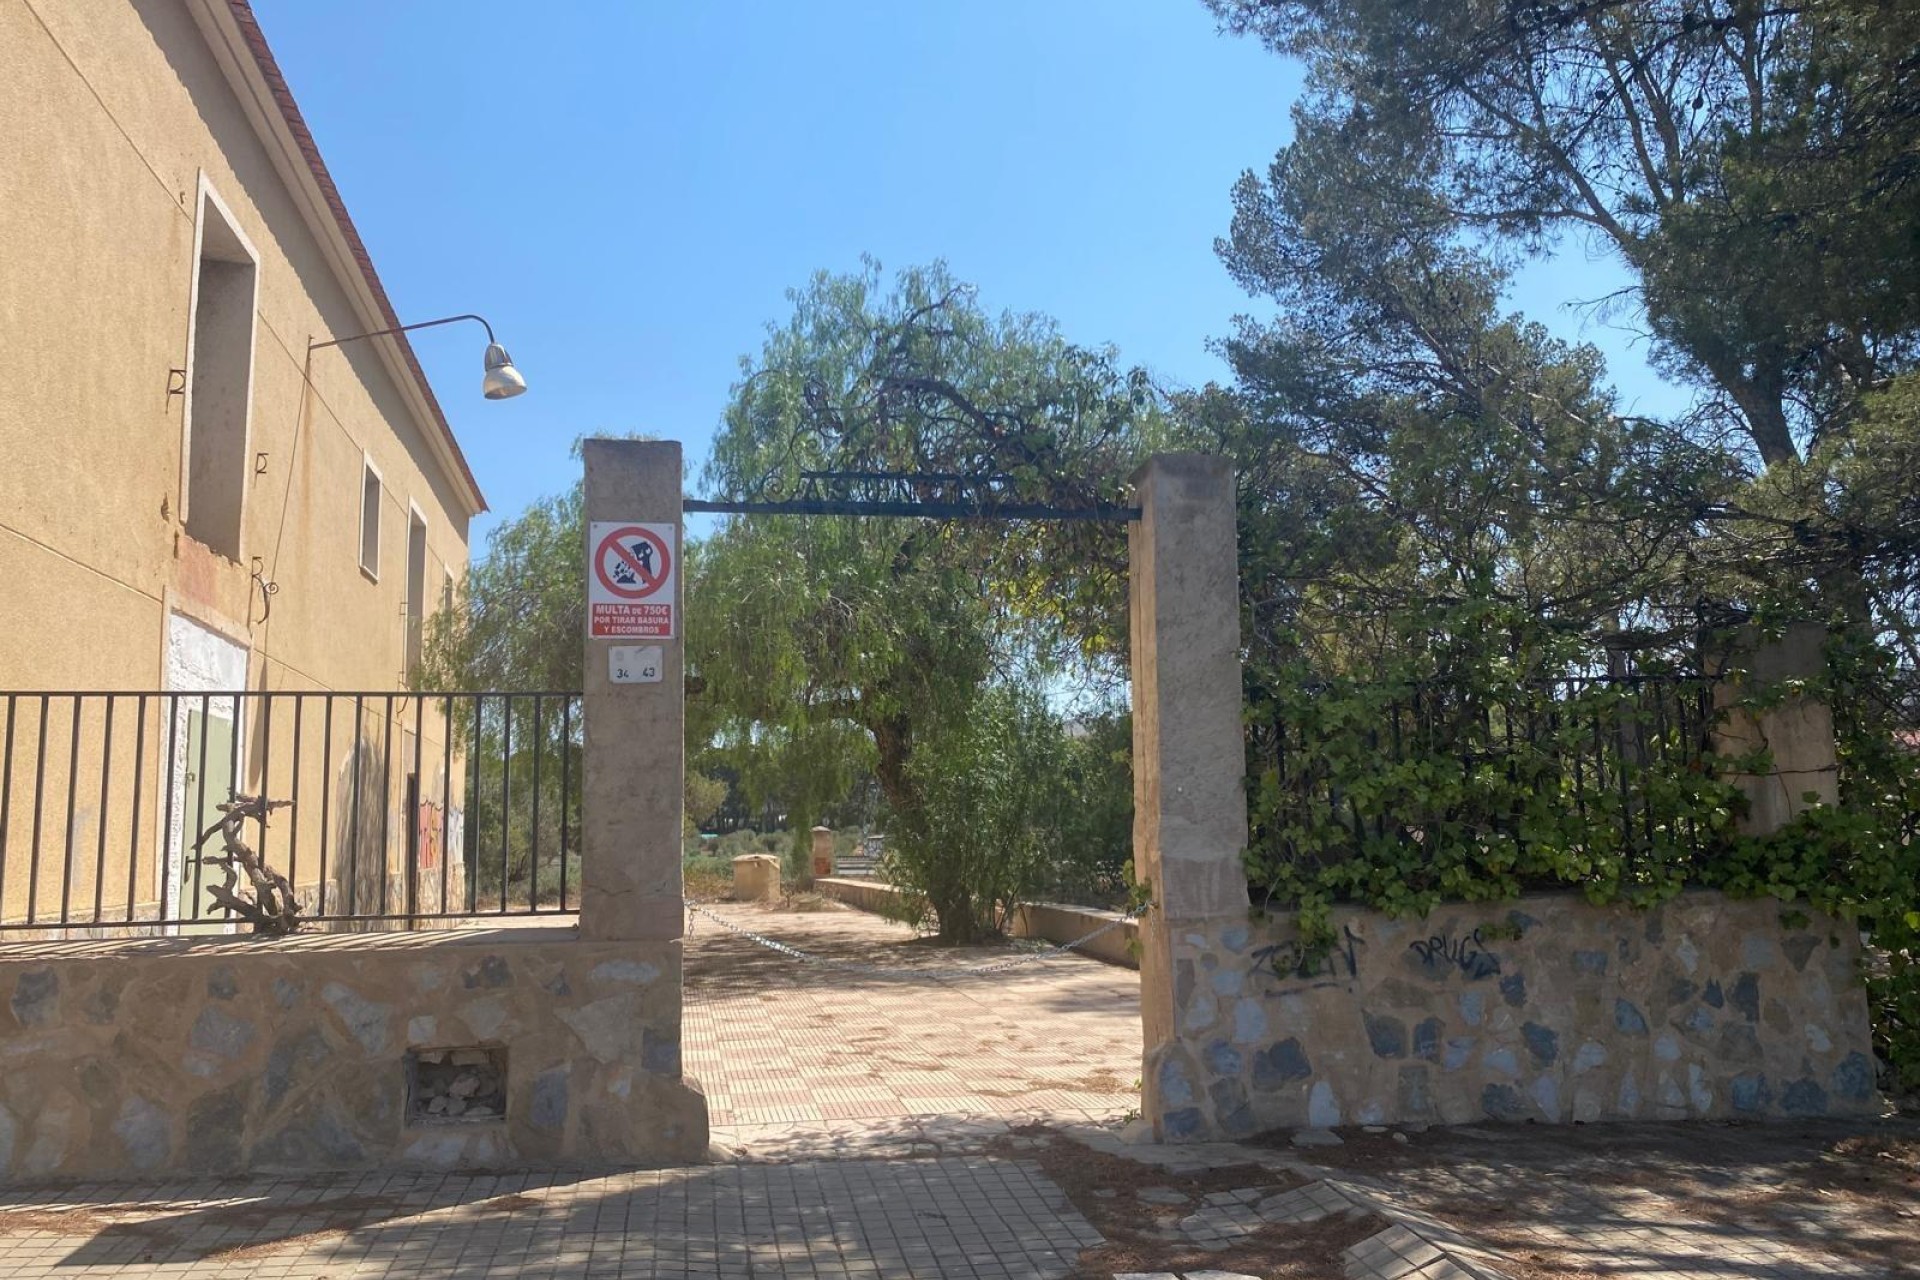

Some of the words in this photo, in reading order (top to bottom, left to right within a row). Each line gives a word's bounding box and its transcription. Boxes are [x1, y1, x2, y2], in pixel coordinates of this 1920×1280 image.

[596, 605, 630, 615] MULTA
[643, 605, 668, 615] 750€
[594, 616, 611, 624] POR
[612, 616, 636, 624] TIRAR
[637, 616, 669, 624] BASURA
[604, 626, 610, 634] Y
[611, 626, 660, 634] ESCOMBROS
